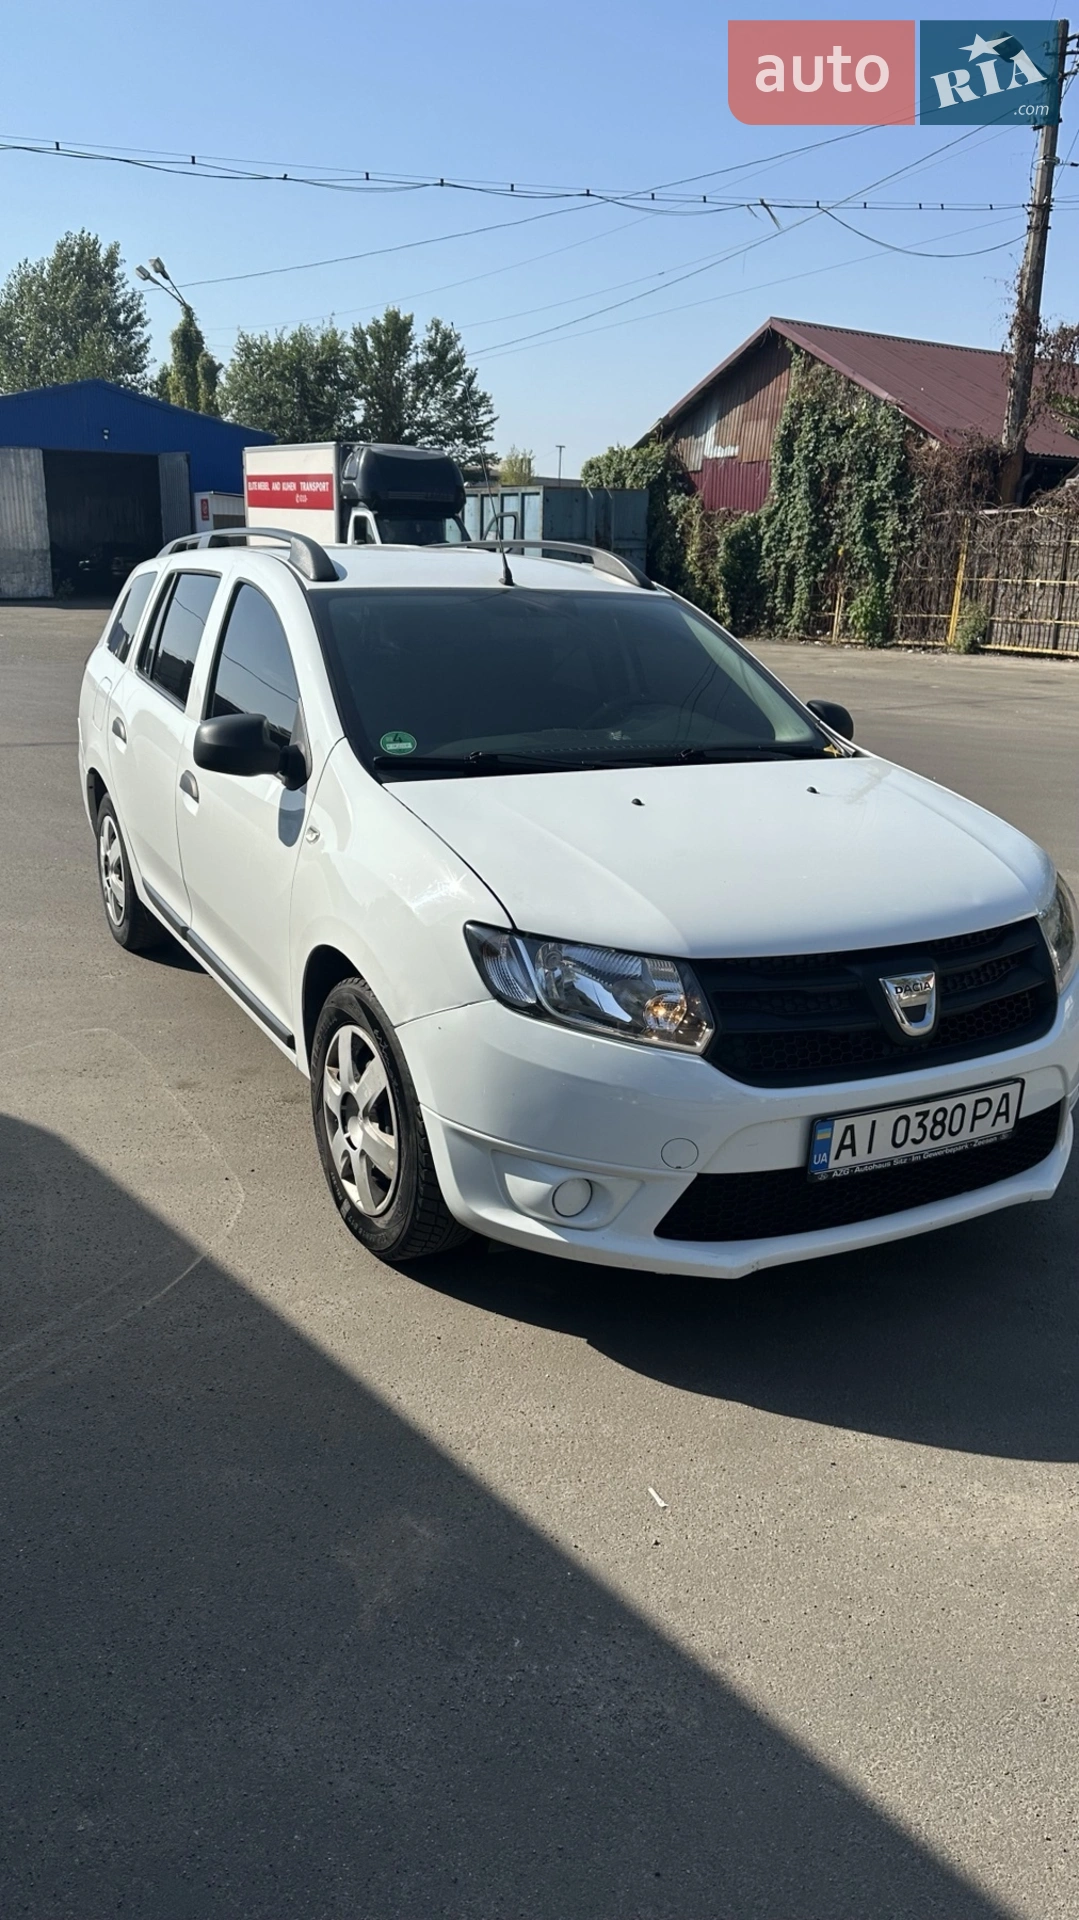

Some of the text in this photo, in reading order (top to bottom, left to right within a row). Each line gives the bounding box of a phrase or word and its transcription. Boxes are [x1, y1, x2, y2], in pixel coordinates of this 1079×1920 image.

[272, 481, 281, 491] AND
[300, 481, 329, 492] TRANSPORT
[894, 981, 931, 994] DACIA
[834, 1092, 1010, 1160] AI 0380 PA
[813, 1152, 828, 1165] UA
[832, 1167, 850, 1178] AZG
[854, 1160, 891, 1173] Autohaus
[923, 1143, 968, 1159] Gewerbepark
